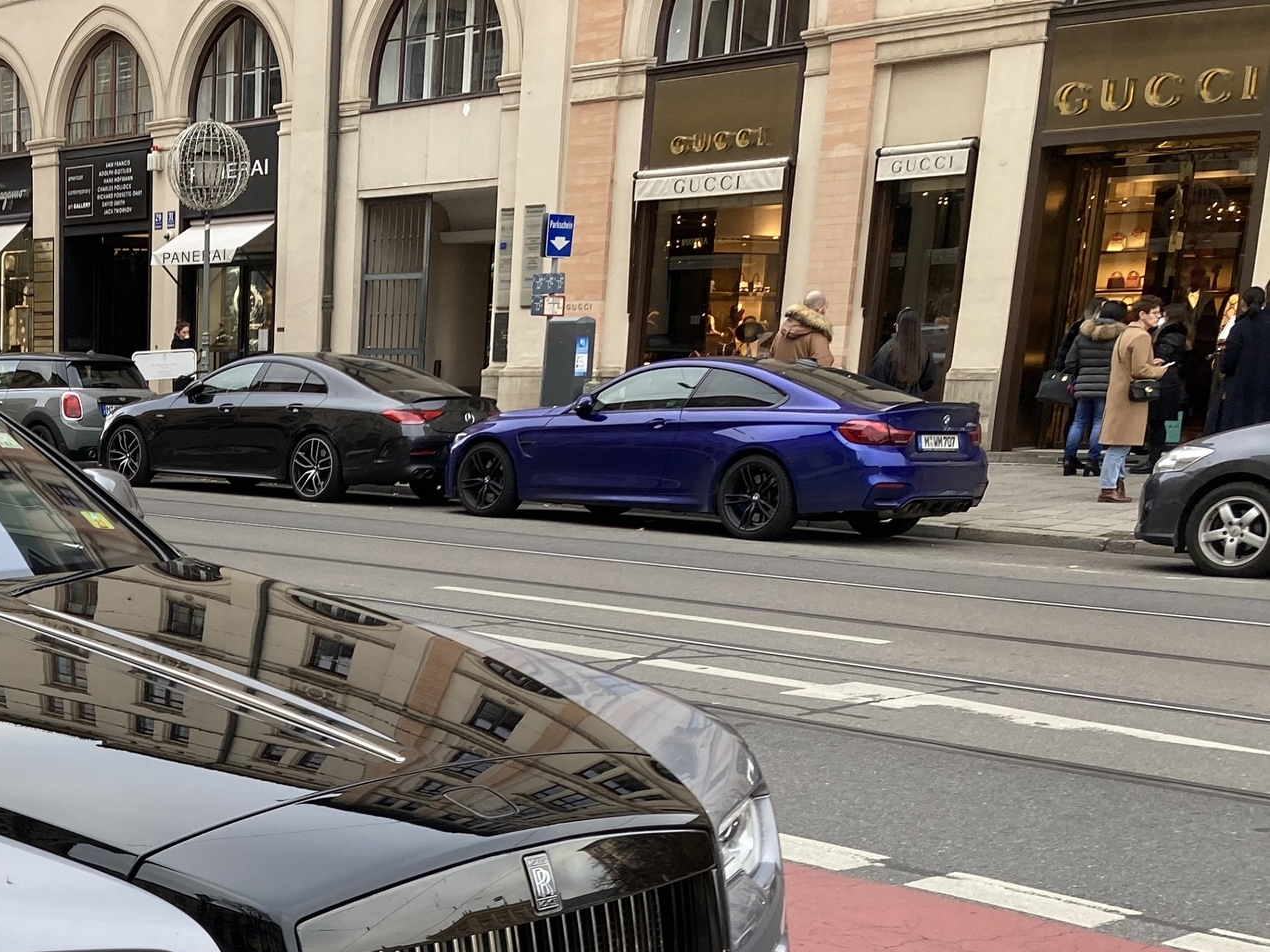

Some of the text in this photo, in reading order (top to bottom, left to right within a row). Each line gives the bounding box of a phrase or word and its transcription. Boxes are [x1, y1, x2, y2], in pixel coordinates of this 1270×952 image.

[1054, 65, 1258, 116] GUCCI
[670, 126, 767, 155] GUCCI
[891, 155, 954, 174] GUCCI
[673, 175, 741, 194] GUCCI
[550, 219, 573, 230] Parkschein
[566, 303, 593, 311] GUCCI
